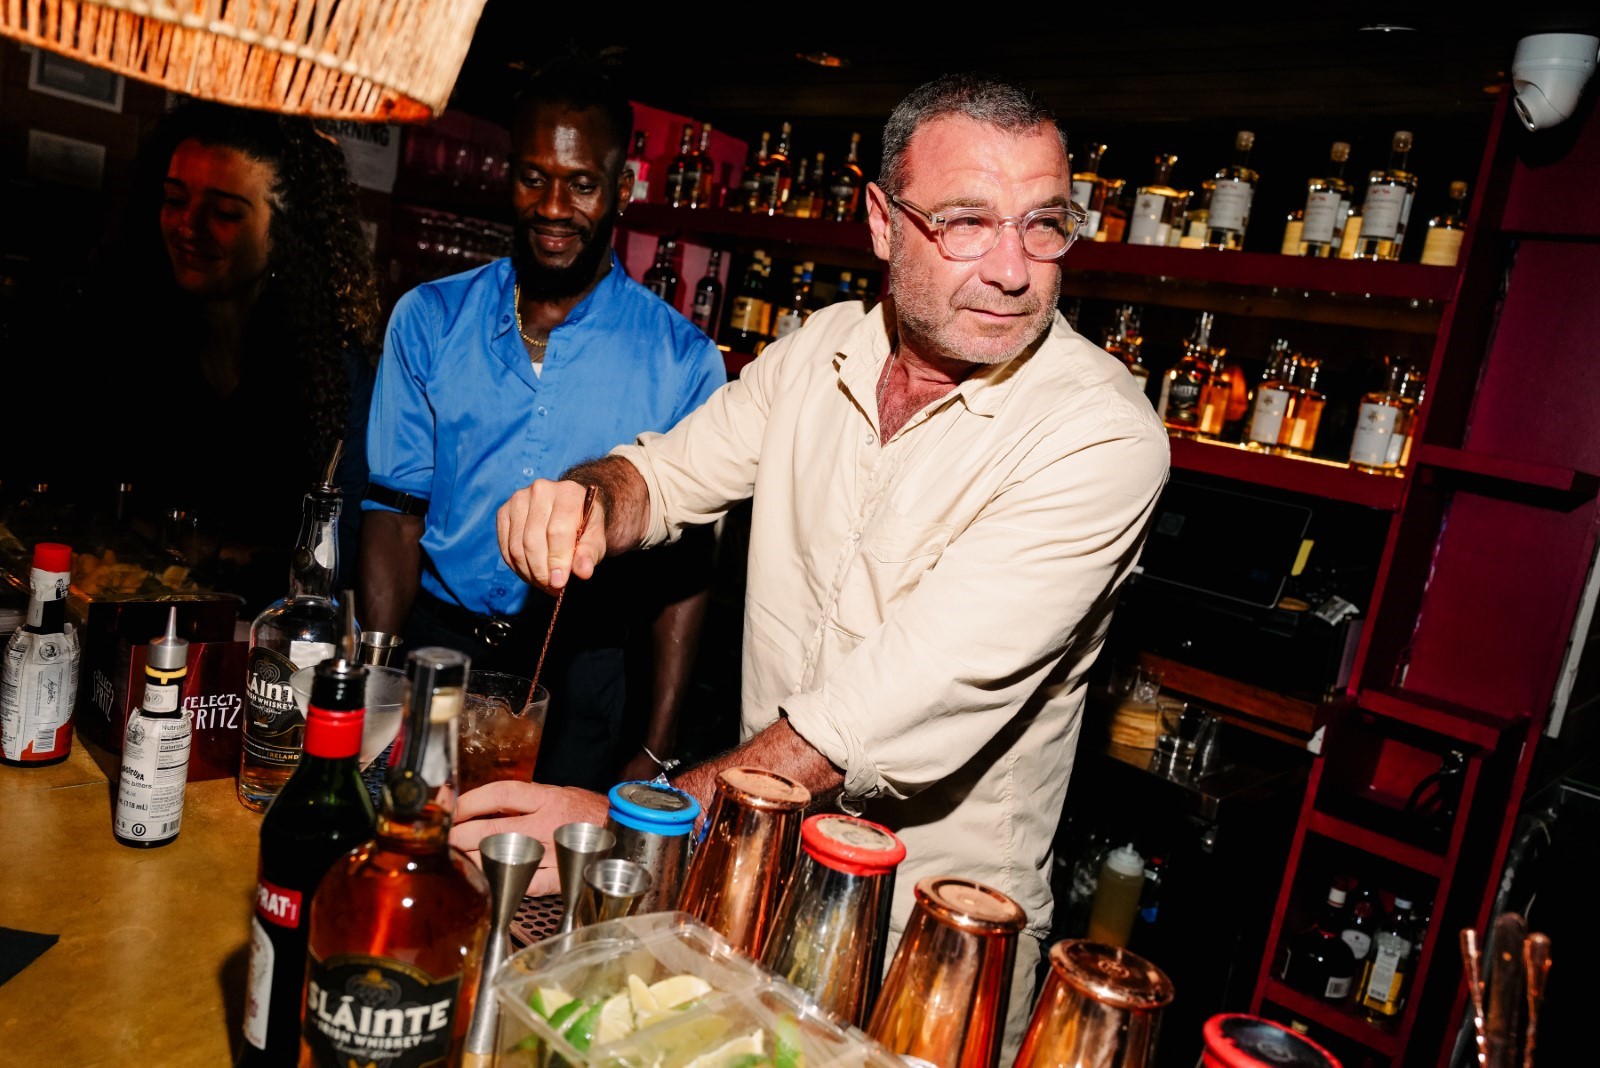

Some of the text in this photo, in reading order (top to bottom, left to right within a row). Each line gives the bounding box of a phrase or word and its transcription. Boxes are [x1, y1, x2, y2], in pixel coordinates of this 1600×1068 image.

[258, 697, 294, 710] WHISKEY
[267, 751, 299, 760] IRELAND
[353, 1033, 422, 1050] WHISKEY
